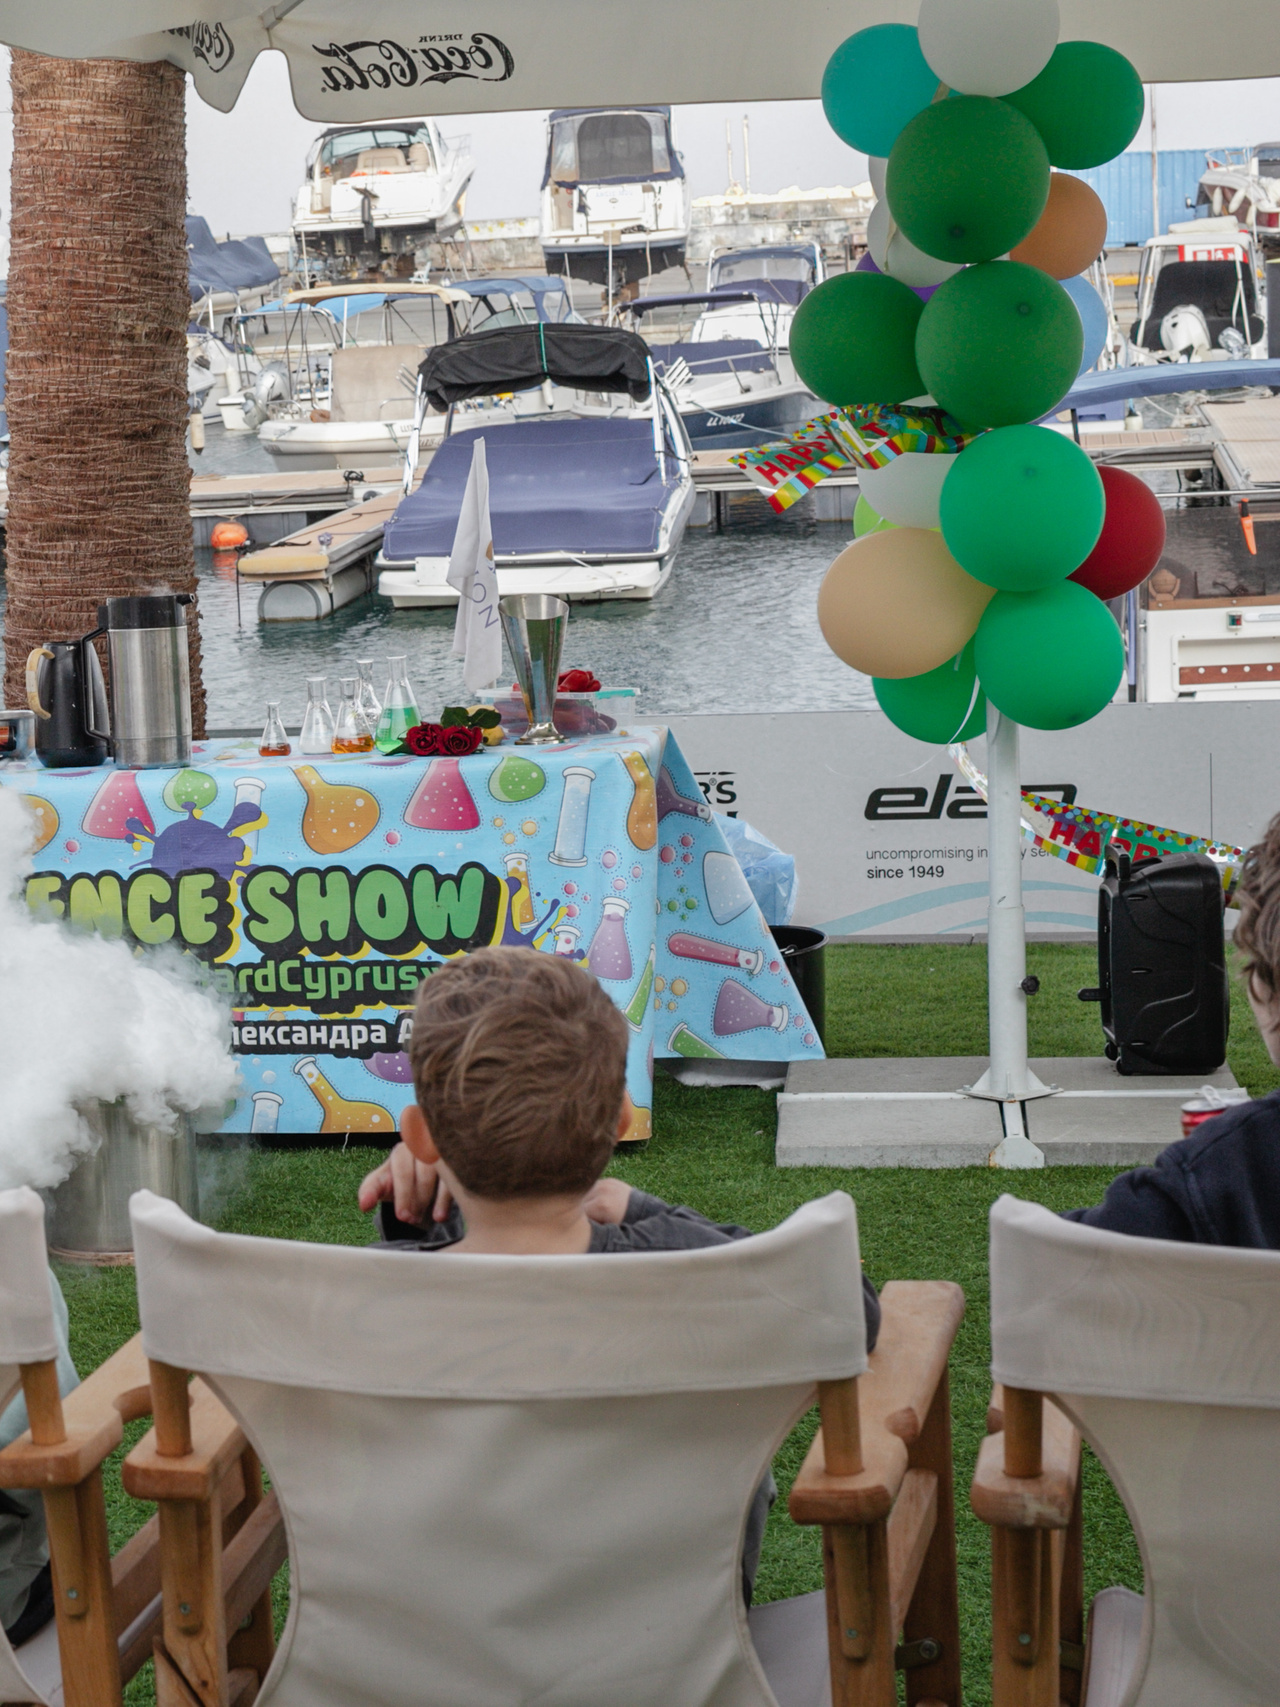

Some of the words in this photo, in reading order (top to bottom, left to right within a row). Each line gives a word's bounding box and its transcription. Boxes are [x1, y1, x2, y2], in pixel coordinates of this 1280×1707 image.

[866, 847, 974, 862] uncompromising
[867, 867, 904, 879] since
[908, 865, 945, 878] 1949
[246, 867, 486, 943] SHOW
